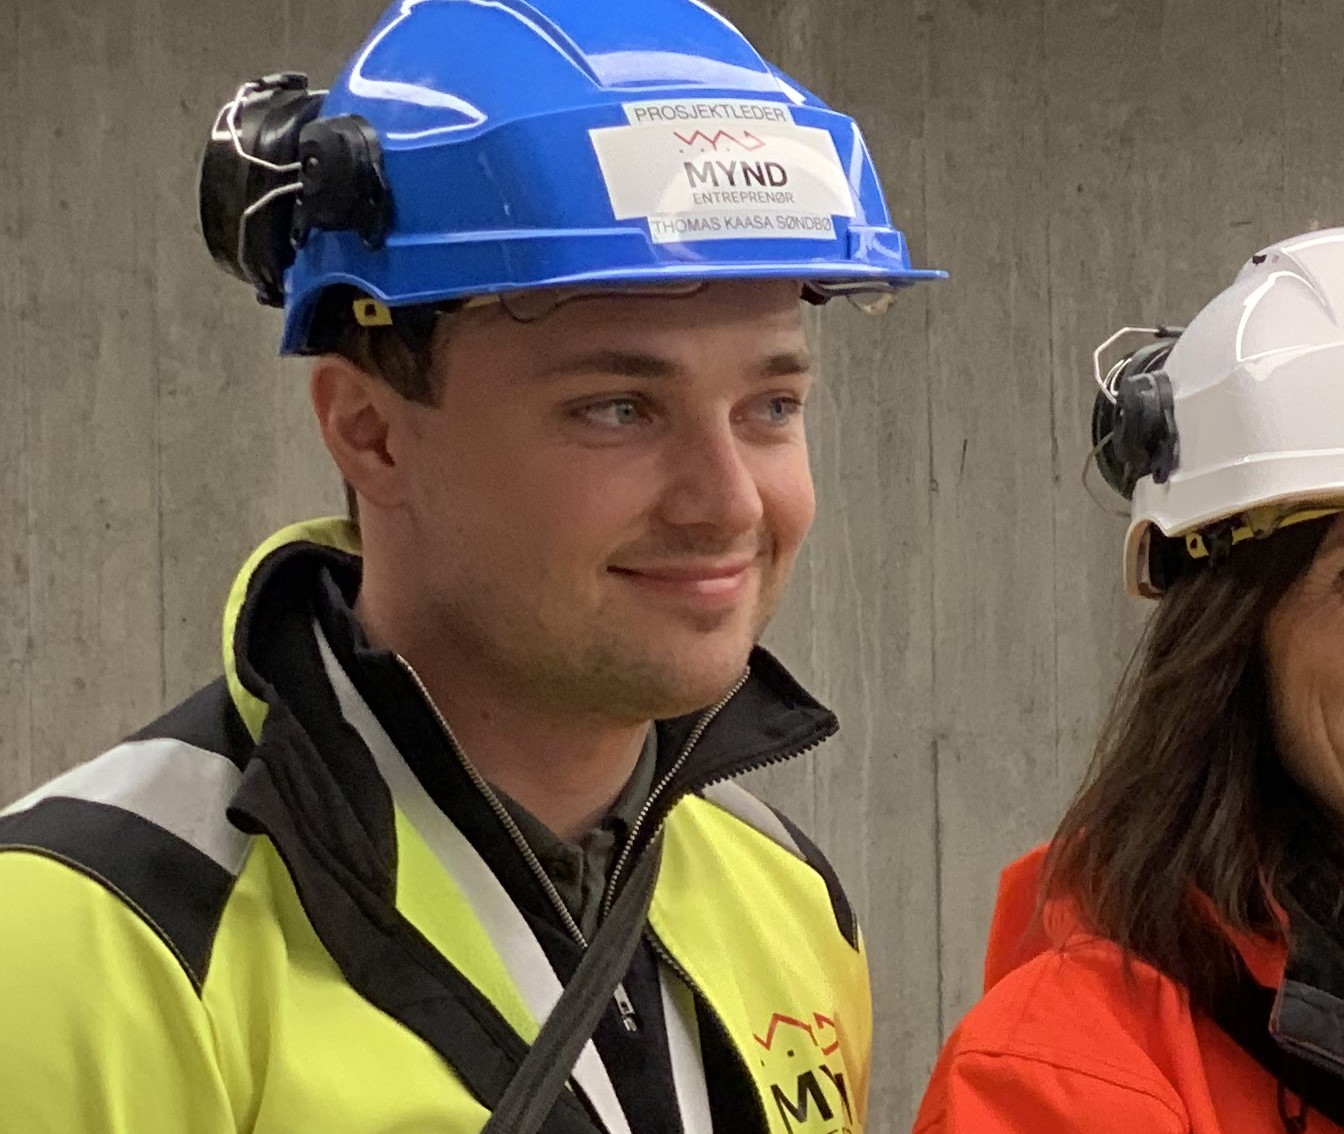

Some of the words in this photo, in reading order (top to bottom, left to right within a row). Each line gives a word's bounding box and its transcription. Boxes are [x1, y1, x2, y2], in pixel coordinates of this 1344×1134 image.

[634, 104, 787, 124] PROSJEKTLEDER
[684, 161, 788, 188] MYND
[693, 191, 795, 205] ENTREPRENØR
[654, 215, 722, 234] THOMAS
[725, 214, 774, 230] KAASA
